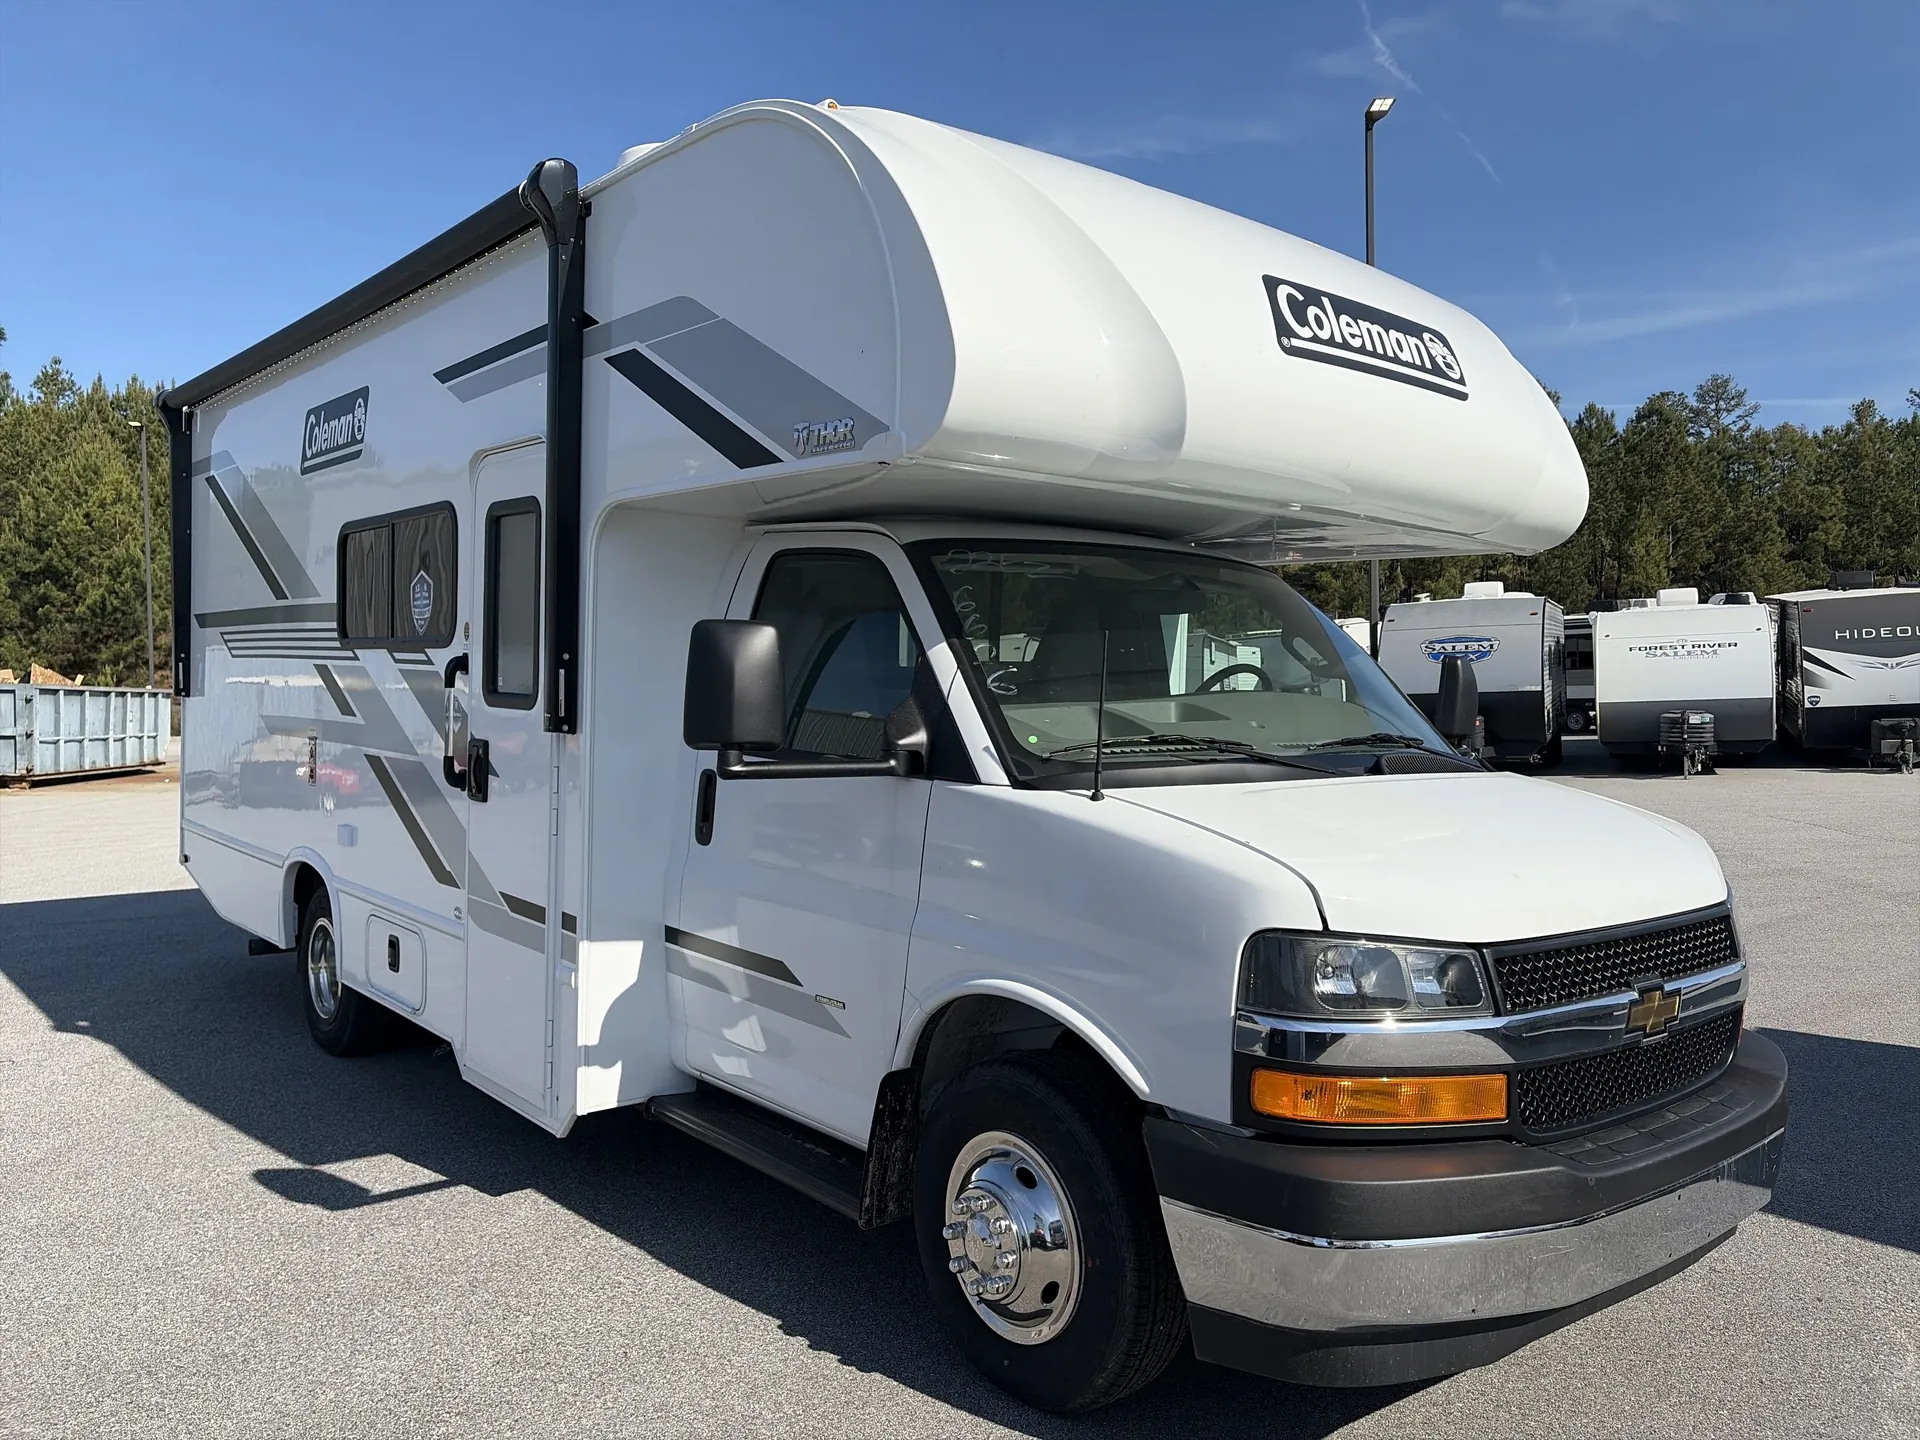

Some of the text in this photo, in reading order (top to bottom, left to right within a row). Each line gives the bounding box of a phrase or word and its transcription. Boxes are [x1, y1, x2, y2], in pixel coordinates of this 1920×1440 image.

[1276, 283, 1433, 370] Coleman
[305, 410, 353, 459] Coleman
[810, 417, 855, 446] THOR
[1424, 643, 1496, 652] SALEM
[1628, 642, 1738, 652] FOREST RIVER
[1645, 649, 1720, 659] SALEM
